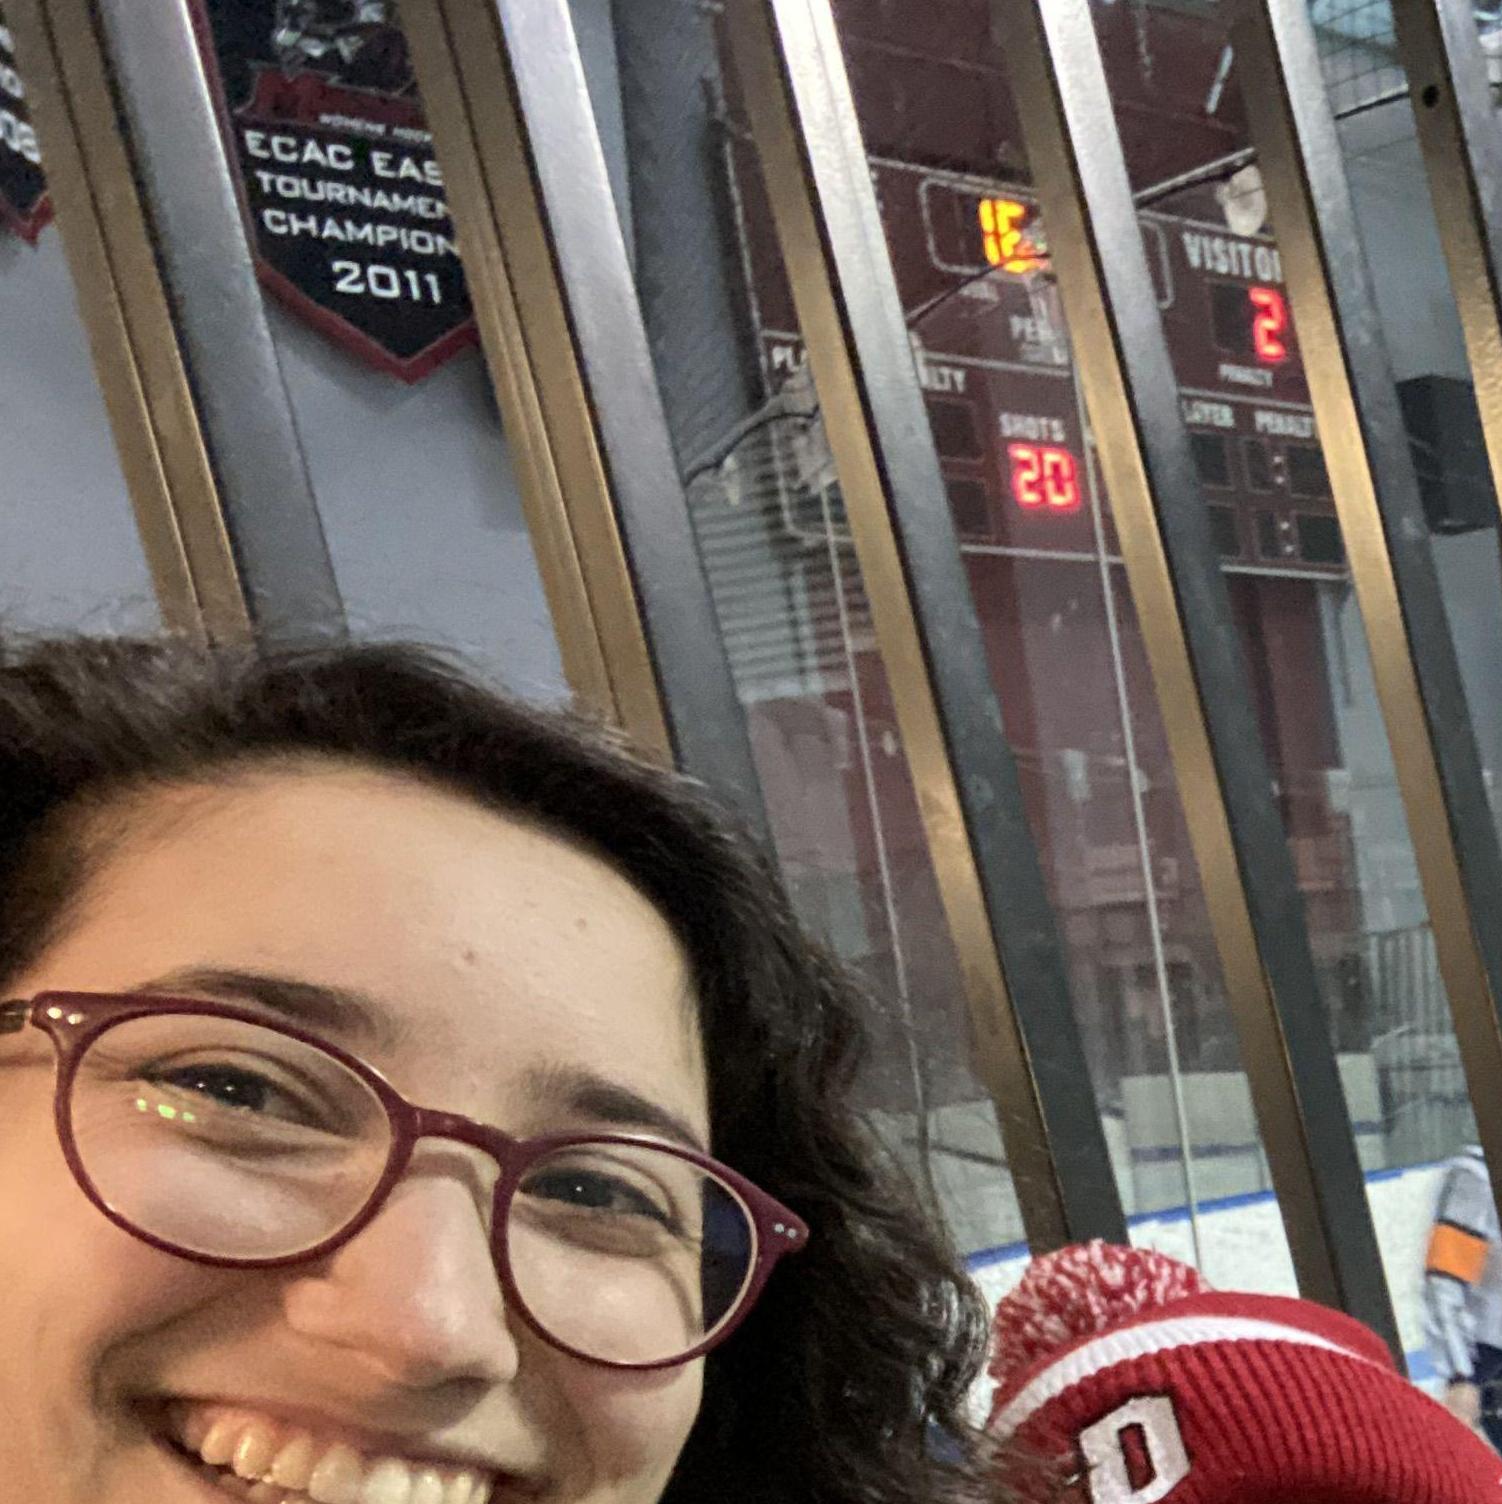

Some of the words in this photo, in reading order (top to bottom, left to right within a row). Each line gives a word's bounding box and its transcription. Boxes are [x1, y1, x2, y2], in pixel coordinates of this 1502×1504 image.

[244, 130, 355, 170] ECAC
[371, 151, 444, 187] EAS
[255, 170, 450, 220] TOURNAMEN
[262, 208, 461, 255] CHAMPION
[332, 260, 441, 305] 2011
[1248, 285, 1287, 362] 2
[1008, 443, 1082, 514] 20
